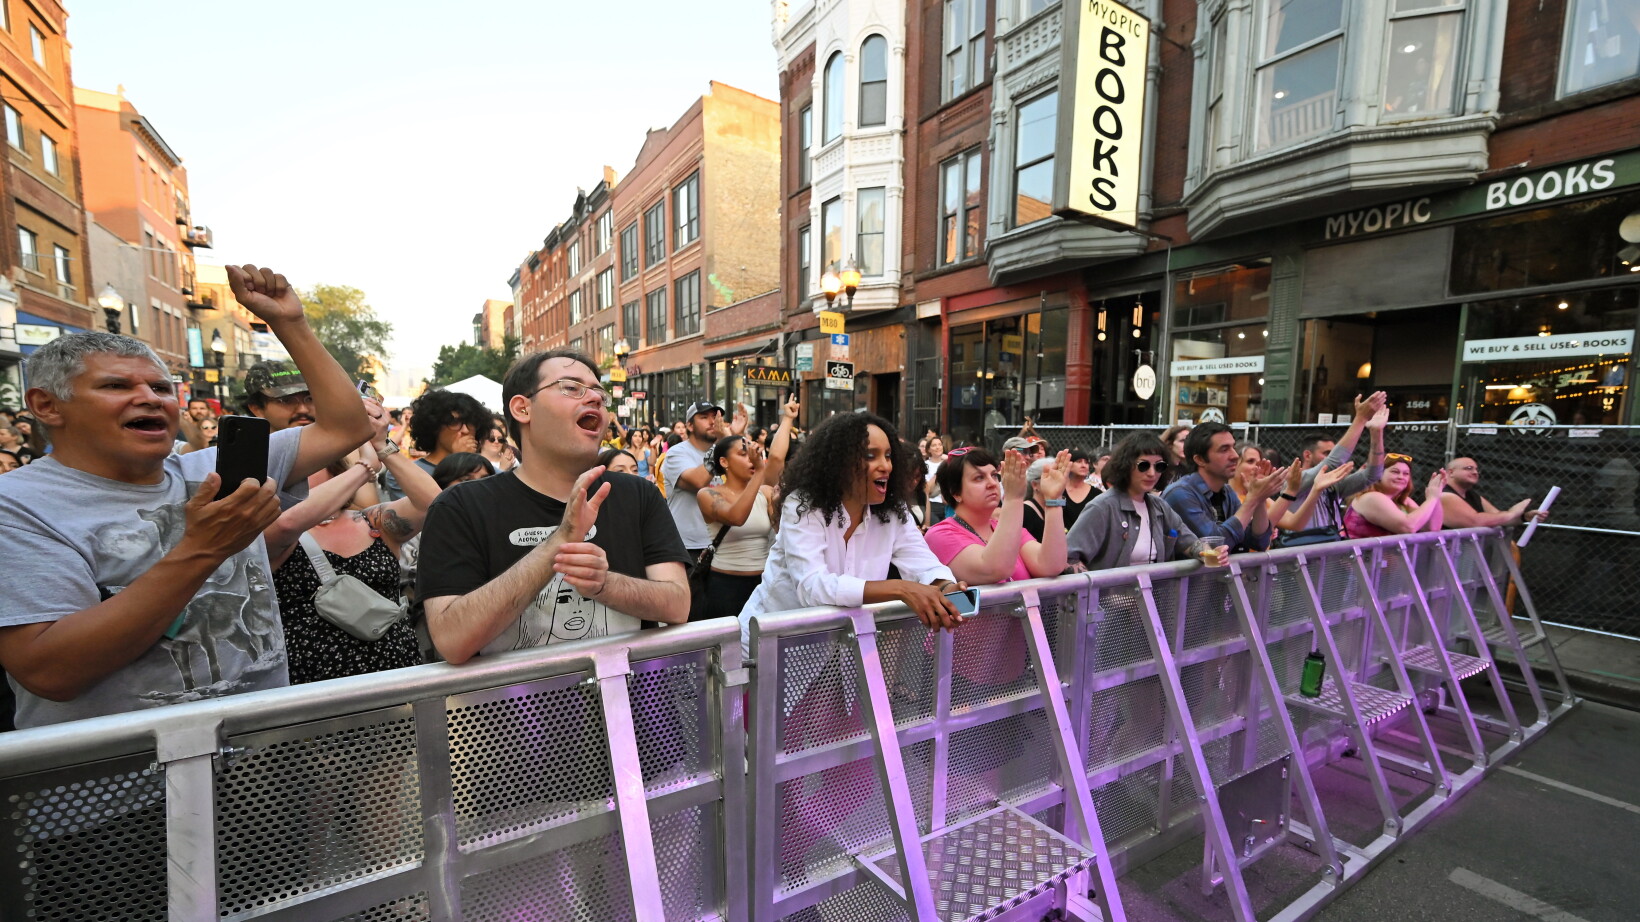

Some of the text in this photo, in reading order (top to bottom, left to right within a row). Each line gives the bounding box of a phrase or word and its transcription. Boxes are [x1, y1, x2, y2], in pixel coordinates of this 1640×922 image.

[1089, 0, 1141, 38] MYOPIC
[1089, 25, 1126, 212] BOOKS
[1325, 159, 1615, 239] MYOPIC BOOKS
[1469, 346, 1485, 354] WE
[1488, 345, 1508, 353] BUY
[1523, 343, 1546, 351] SELL
[1550, 341, 1578, 350] USED
[1583, 338, 1627, 348] BOOKS
[1406, 401, 1430, 409] 1564
